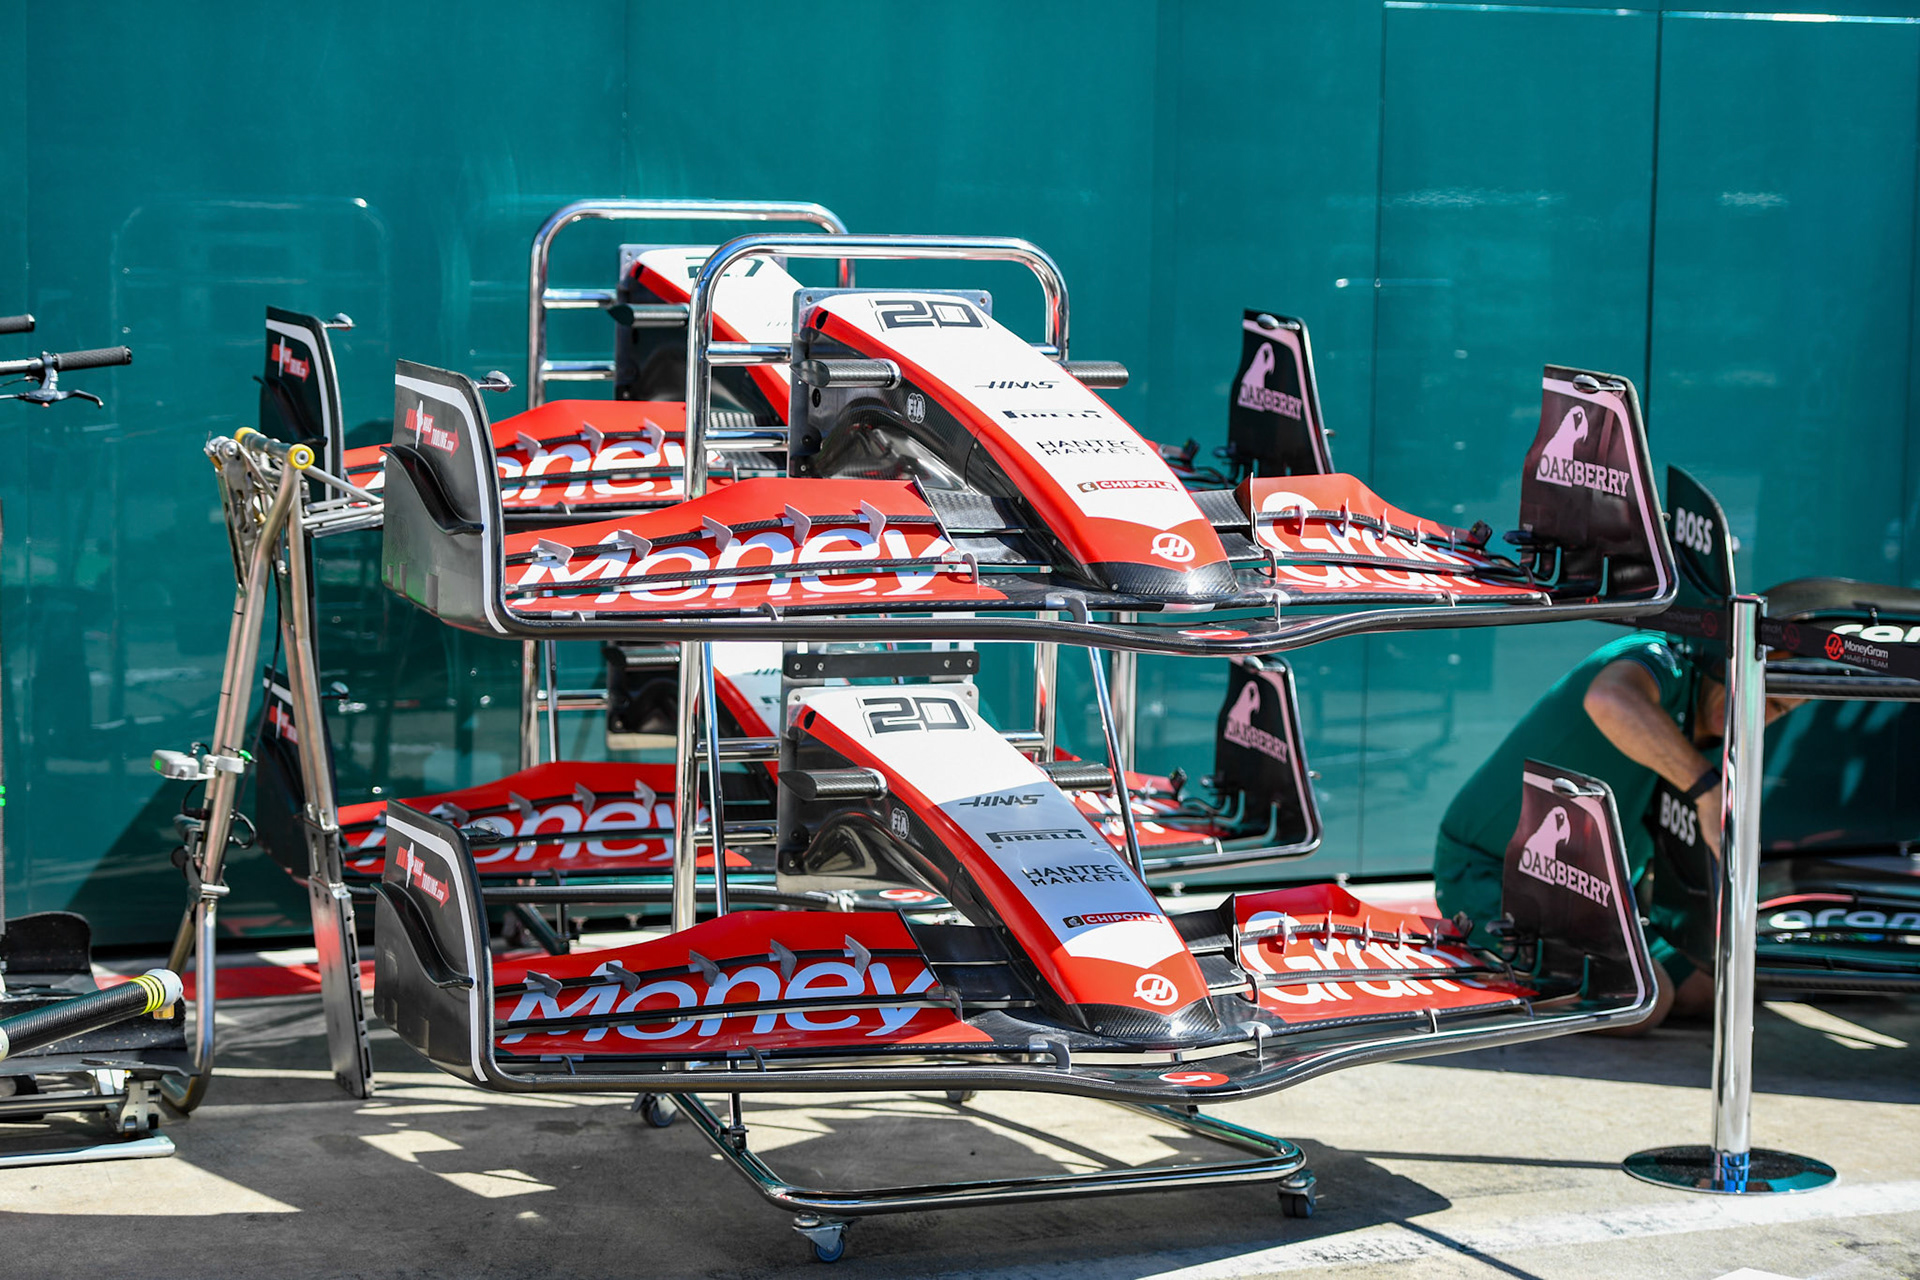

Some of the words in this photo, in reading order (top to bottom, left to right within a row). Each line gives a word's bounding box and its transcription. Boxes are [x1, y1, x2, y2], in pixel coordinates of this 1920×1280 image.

[874, 299, 984, 329] 20
[1238, 382, 1302, 421] OAKBERRY
[1035, 438, 1140, 450] HANTEC
[1536, 454, 1630, 497] OAKBERRY
[1674, 506, 1714, 557] BOSS
[511, 528, 956, 607] Money
[1844, 640, 1889, 659] MoneyGram
[862, 697, 970, 734] 20
[1224, 716, 1288, 764] OAKBERRY
[958, 793, 1045, 808] HAAS
[985, 828, 1088, 844] PIRELLI
[1659, 791, 1698, 848] BOSS
[1021, 863, 1125, 880] HANTEC
[1030, 873, 1131, 888] MARKETS
[1518, 846, 1612, 909] OAKBERRY
[1086, 912, 1164, 925] CHIPOTLE
[501, 959, 937, 1045] Money
